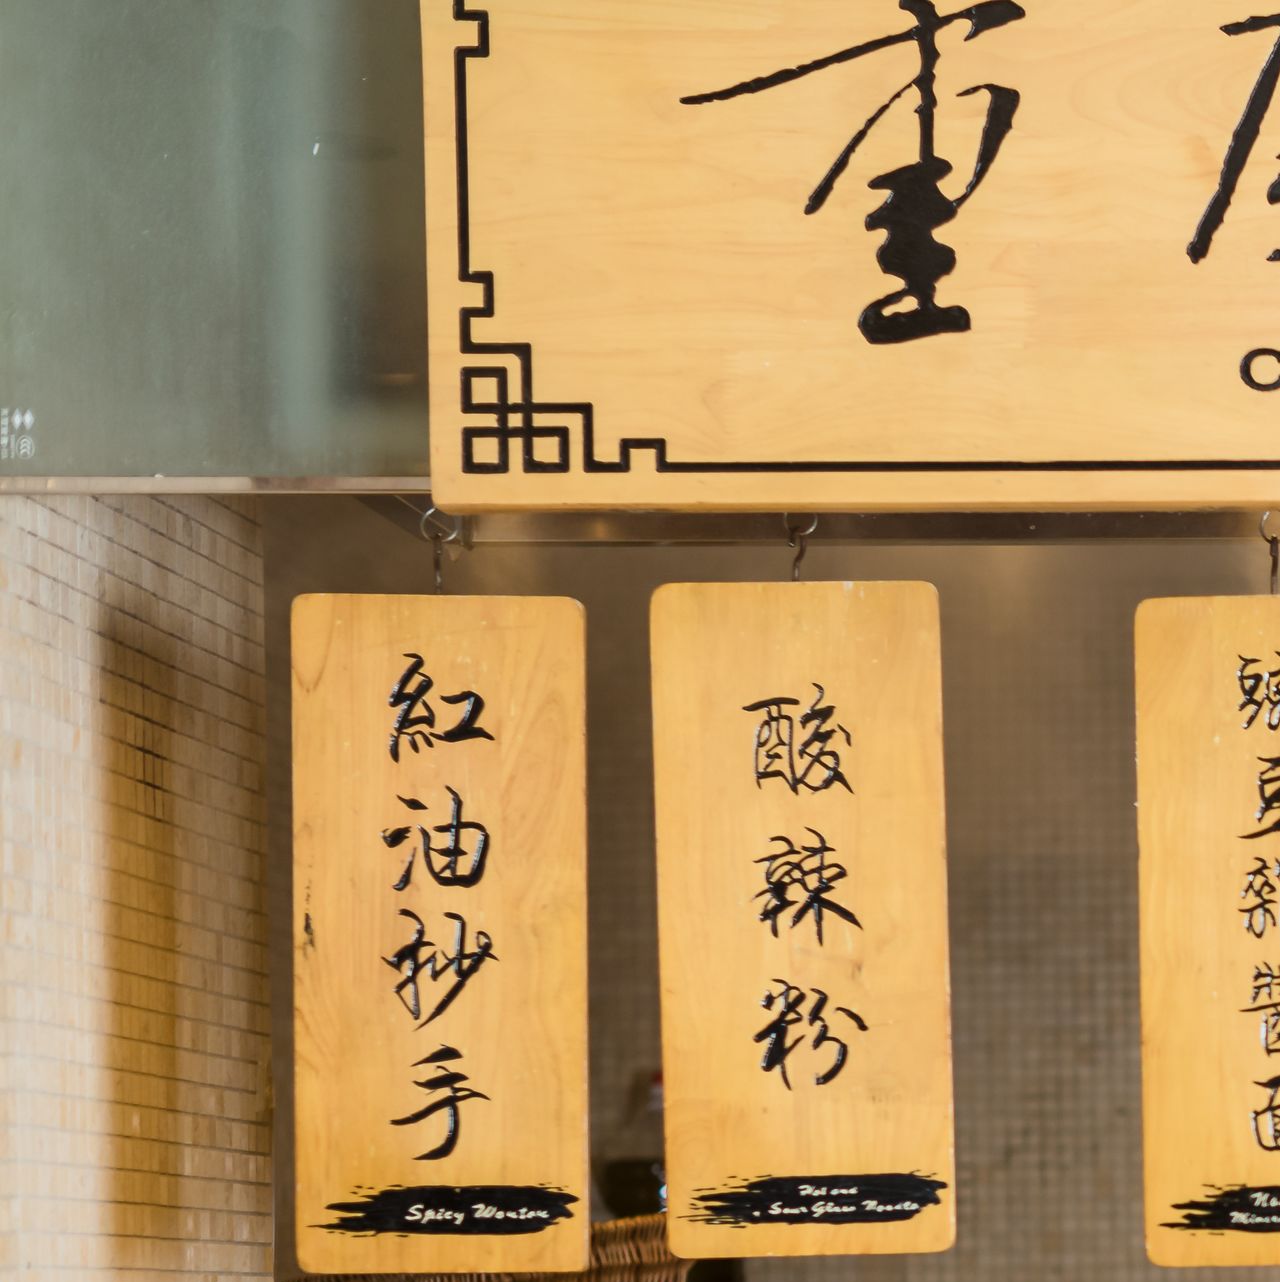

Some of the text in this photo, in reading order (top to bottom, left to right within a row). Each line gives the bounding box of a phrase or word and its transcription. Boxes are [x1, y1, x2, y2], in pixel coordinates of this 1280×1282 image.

[381, 652, 499, 1161] 紅油抄手
[742, 682, 869, 1091] 酸辣粉
[405, 1203, 551, 1226] Spicy Wonton
[768, 1201, 808, 1215] Sour
